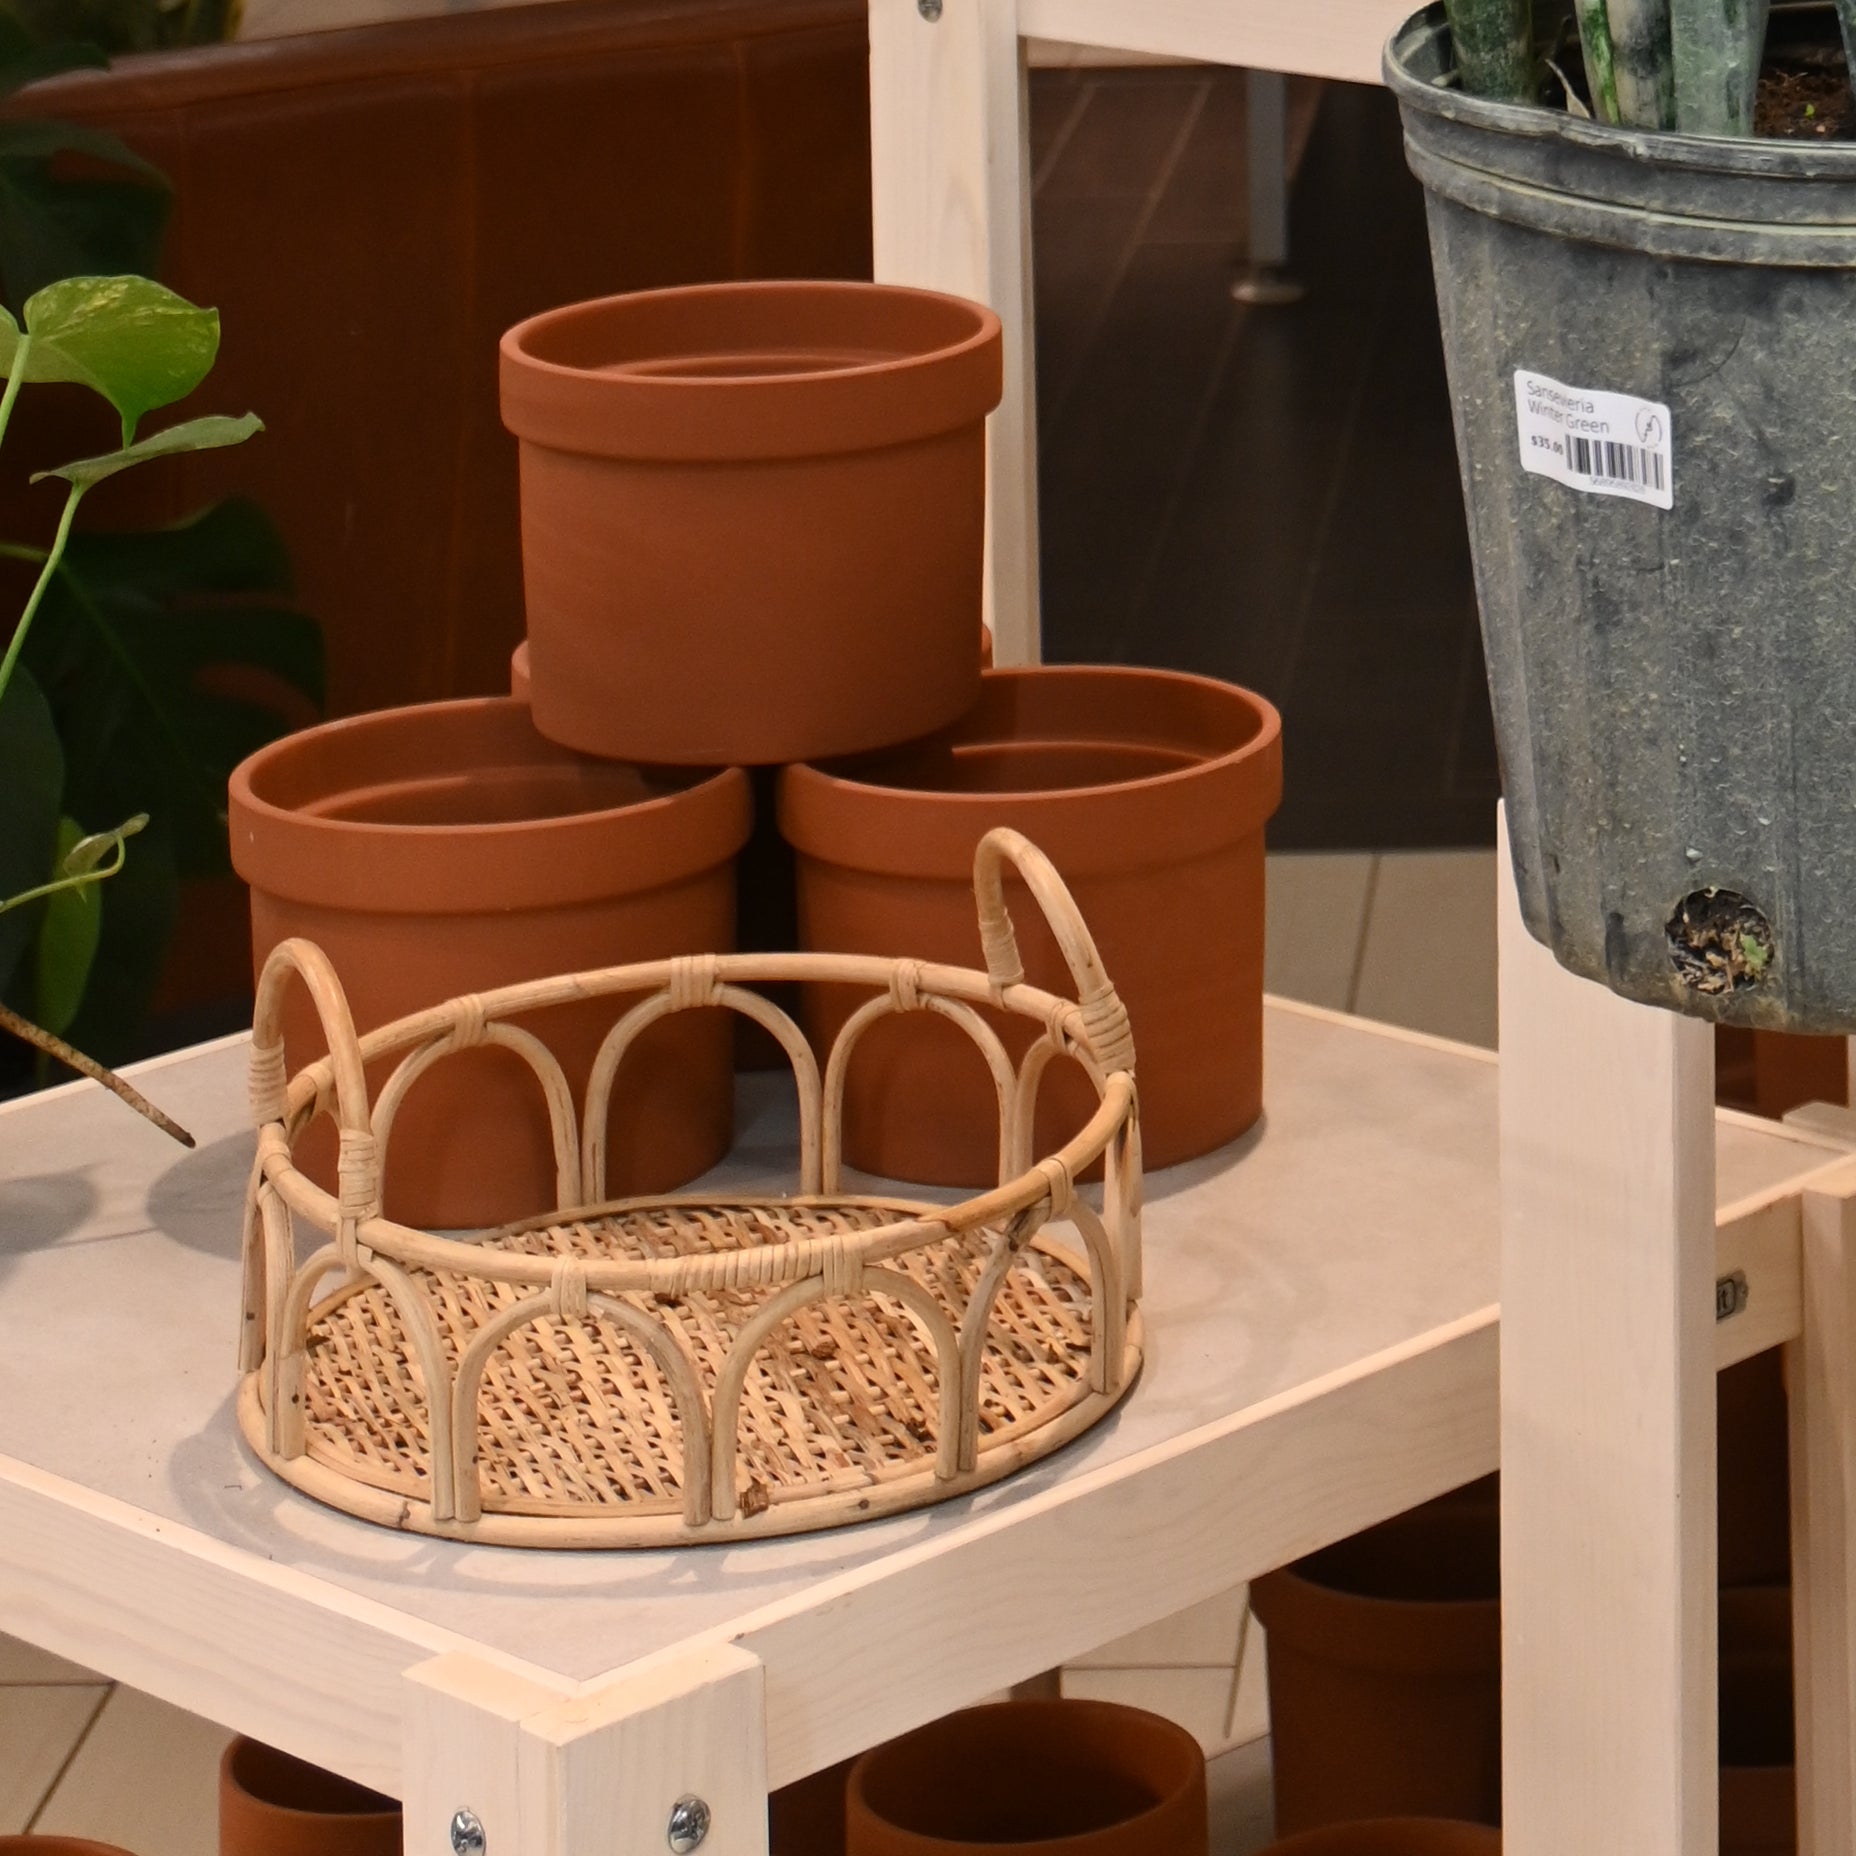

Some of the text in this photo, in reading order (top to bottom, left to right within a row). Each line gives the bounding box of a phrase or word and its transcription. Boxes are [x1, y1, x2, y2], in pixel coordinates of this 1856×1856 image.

[1527, 398, 1611, 434] Winter Green
[1530, 435, 1565, 456] $35.00
